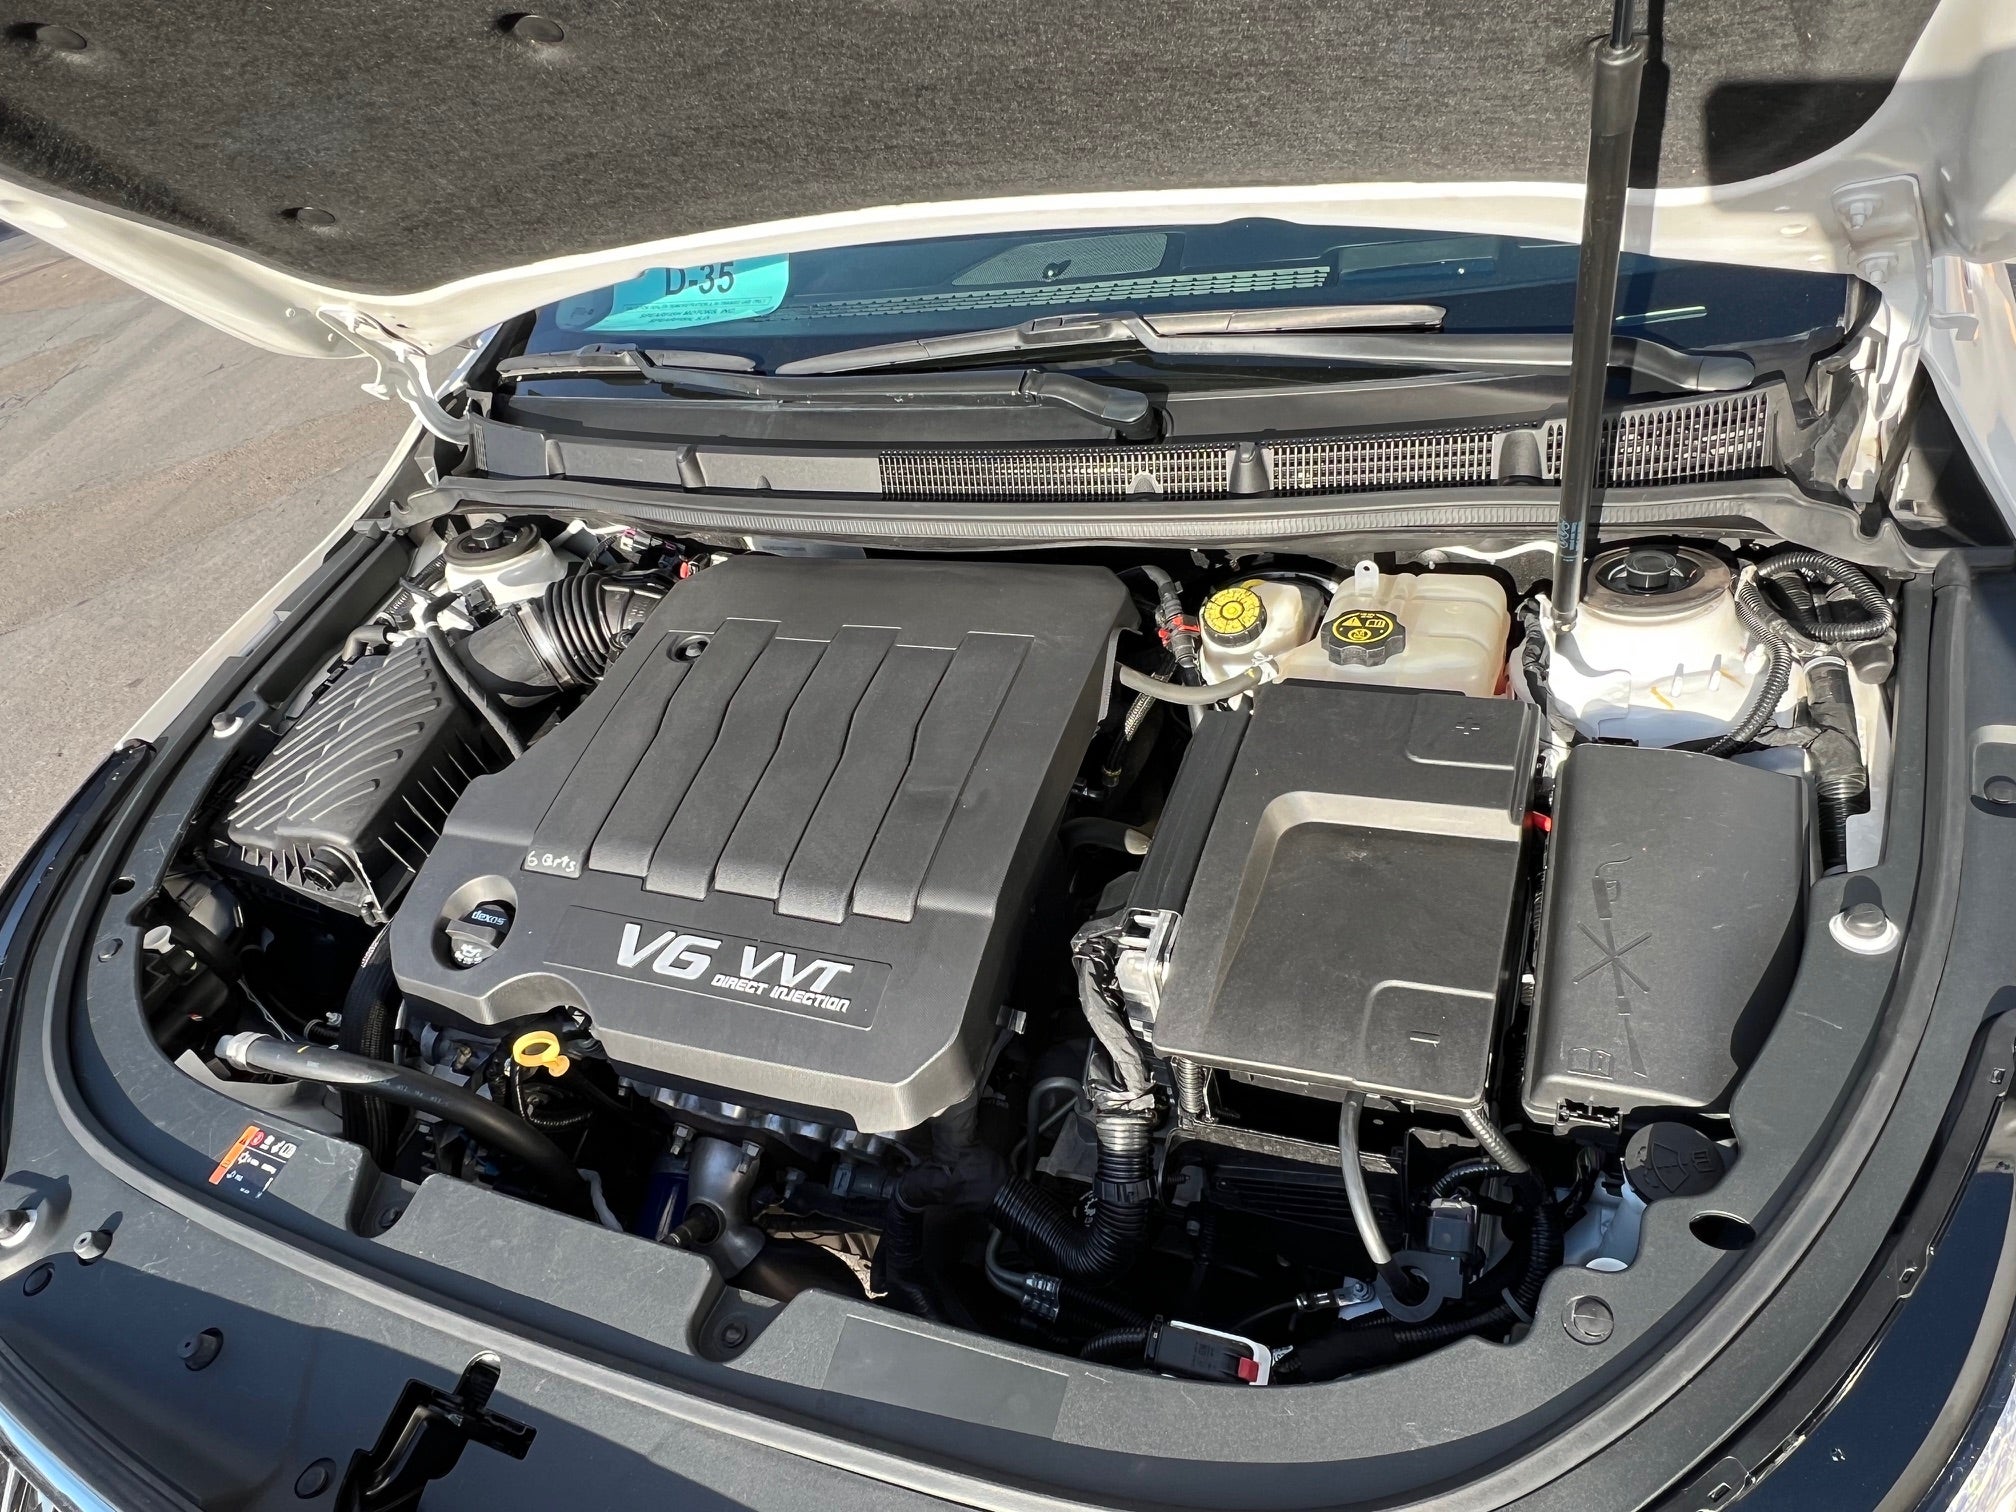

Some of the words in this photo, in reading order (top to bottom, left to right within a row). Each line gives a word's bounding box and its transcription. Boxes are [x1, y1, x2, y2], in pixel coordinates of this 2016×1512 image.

[665, 261, 735, 296] D-35
[528, 851, 538, 867] 6
[471, 910, 507, 926] dexos
[616, 922, 723, 980] V6
[739, 945, 854, 994] VVT
[711, 973, 769, 998] DIRECT
[768, 987, 851, 1013] INJECTION
